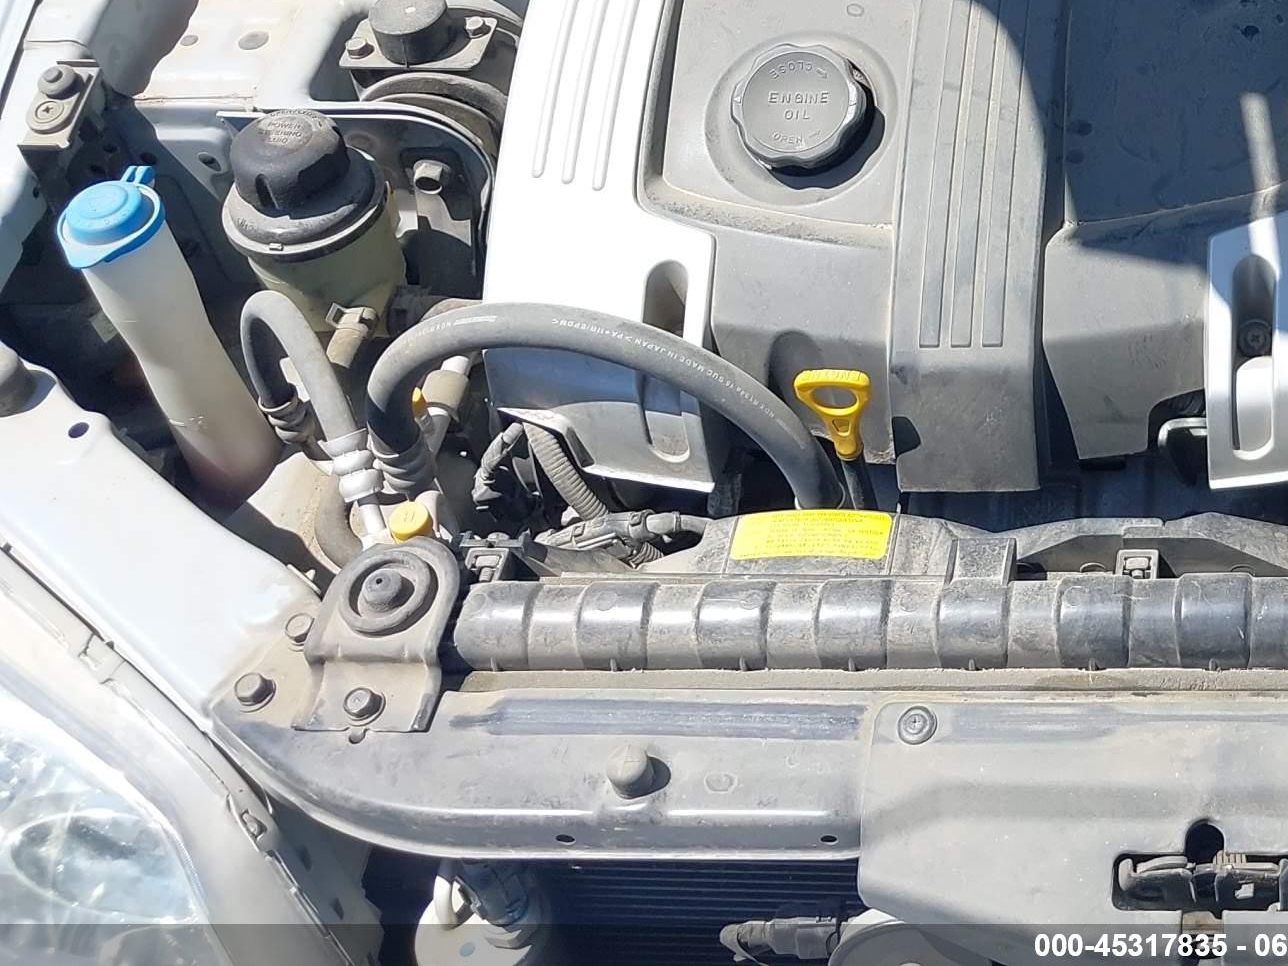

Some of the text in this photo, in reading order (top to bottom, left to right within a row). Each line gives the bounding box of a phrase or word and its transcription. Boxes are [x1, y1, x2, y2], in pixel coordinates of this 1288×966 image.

[769, 61, 813, 80] CLOSE
[767, 92, 831, 104] ENGINE
[783, 109, 812, 120] OIL
[773, 131, 804, 145] OPEN
[634, 338, 666, 354] JAPAN
